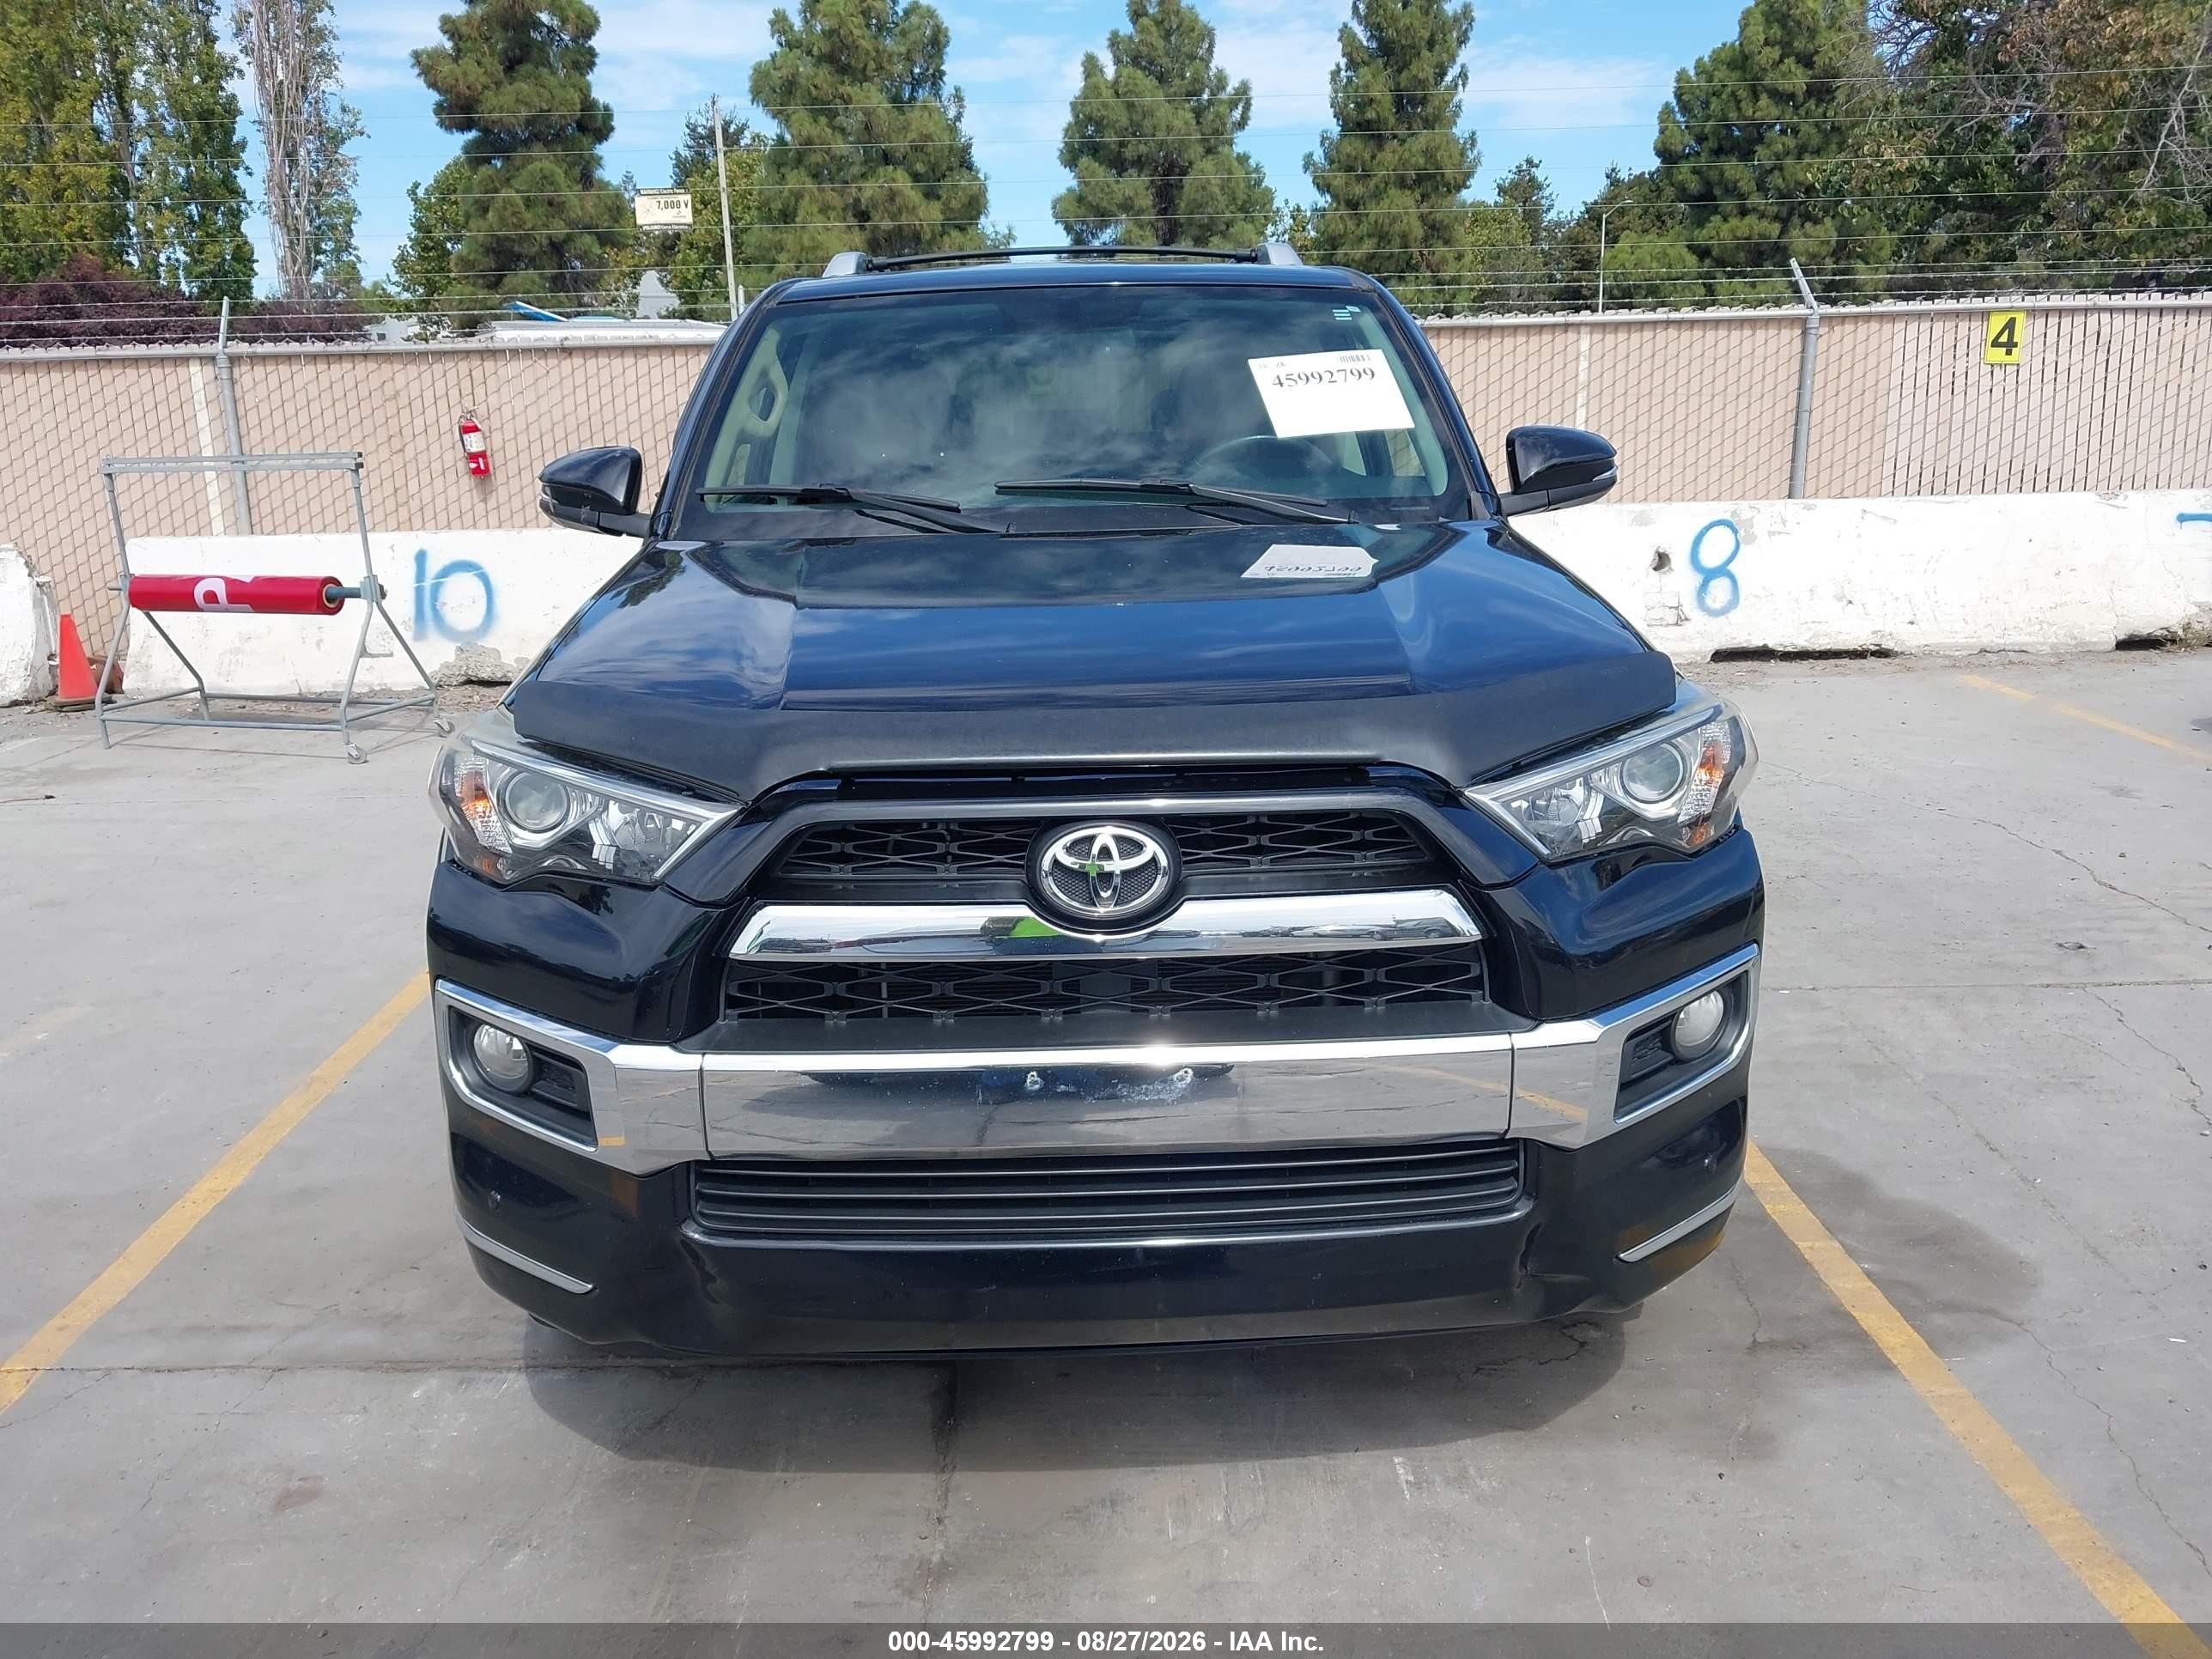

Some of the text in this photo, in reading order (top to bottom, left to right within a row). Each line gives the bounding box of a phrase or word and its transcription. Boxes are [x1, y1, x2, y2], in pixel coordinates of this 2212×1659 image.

[656, 198, 690, 211] 7,000 V
[1990, 317, 2018, 356] 4
[1273, 367, 1375, 387] 45992799
[1690, 519, 1740, 618] 8
[414, 548, 495, 644] 10
